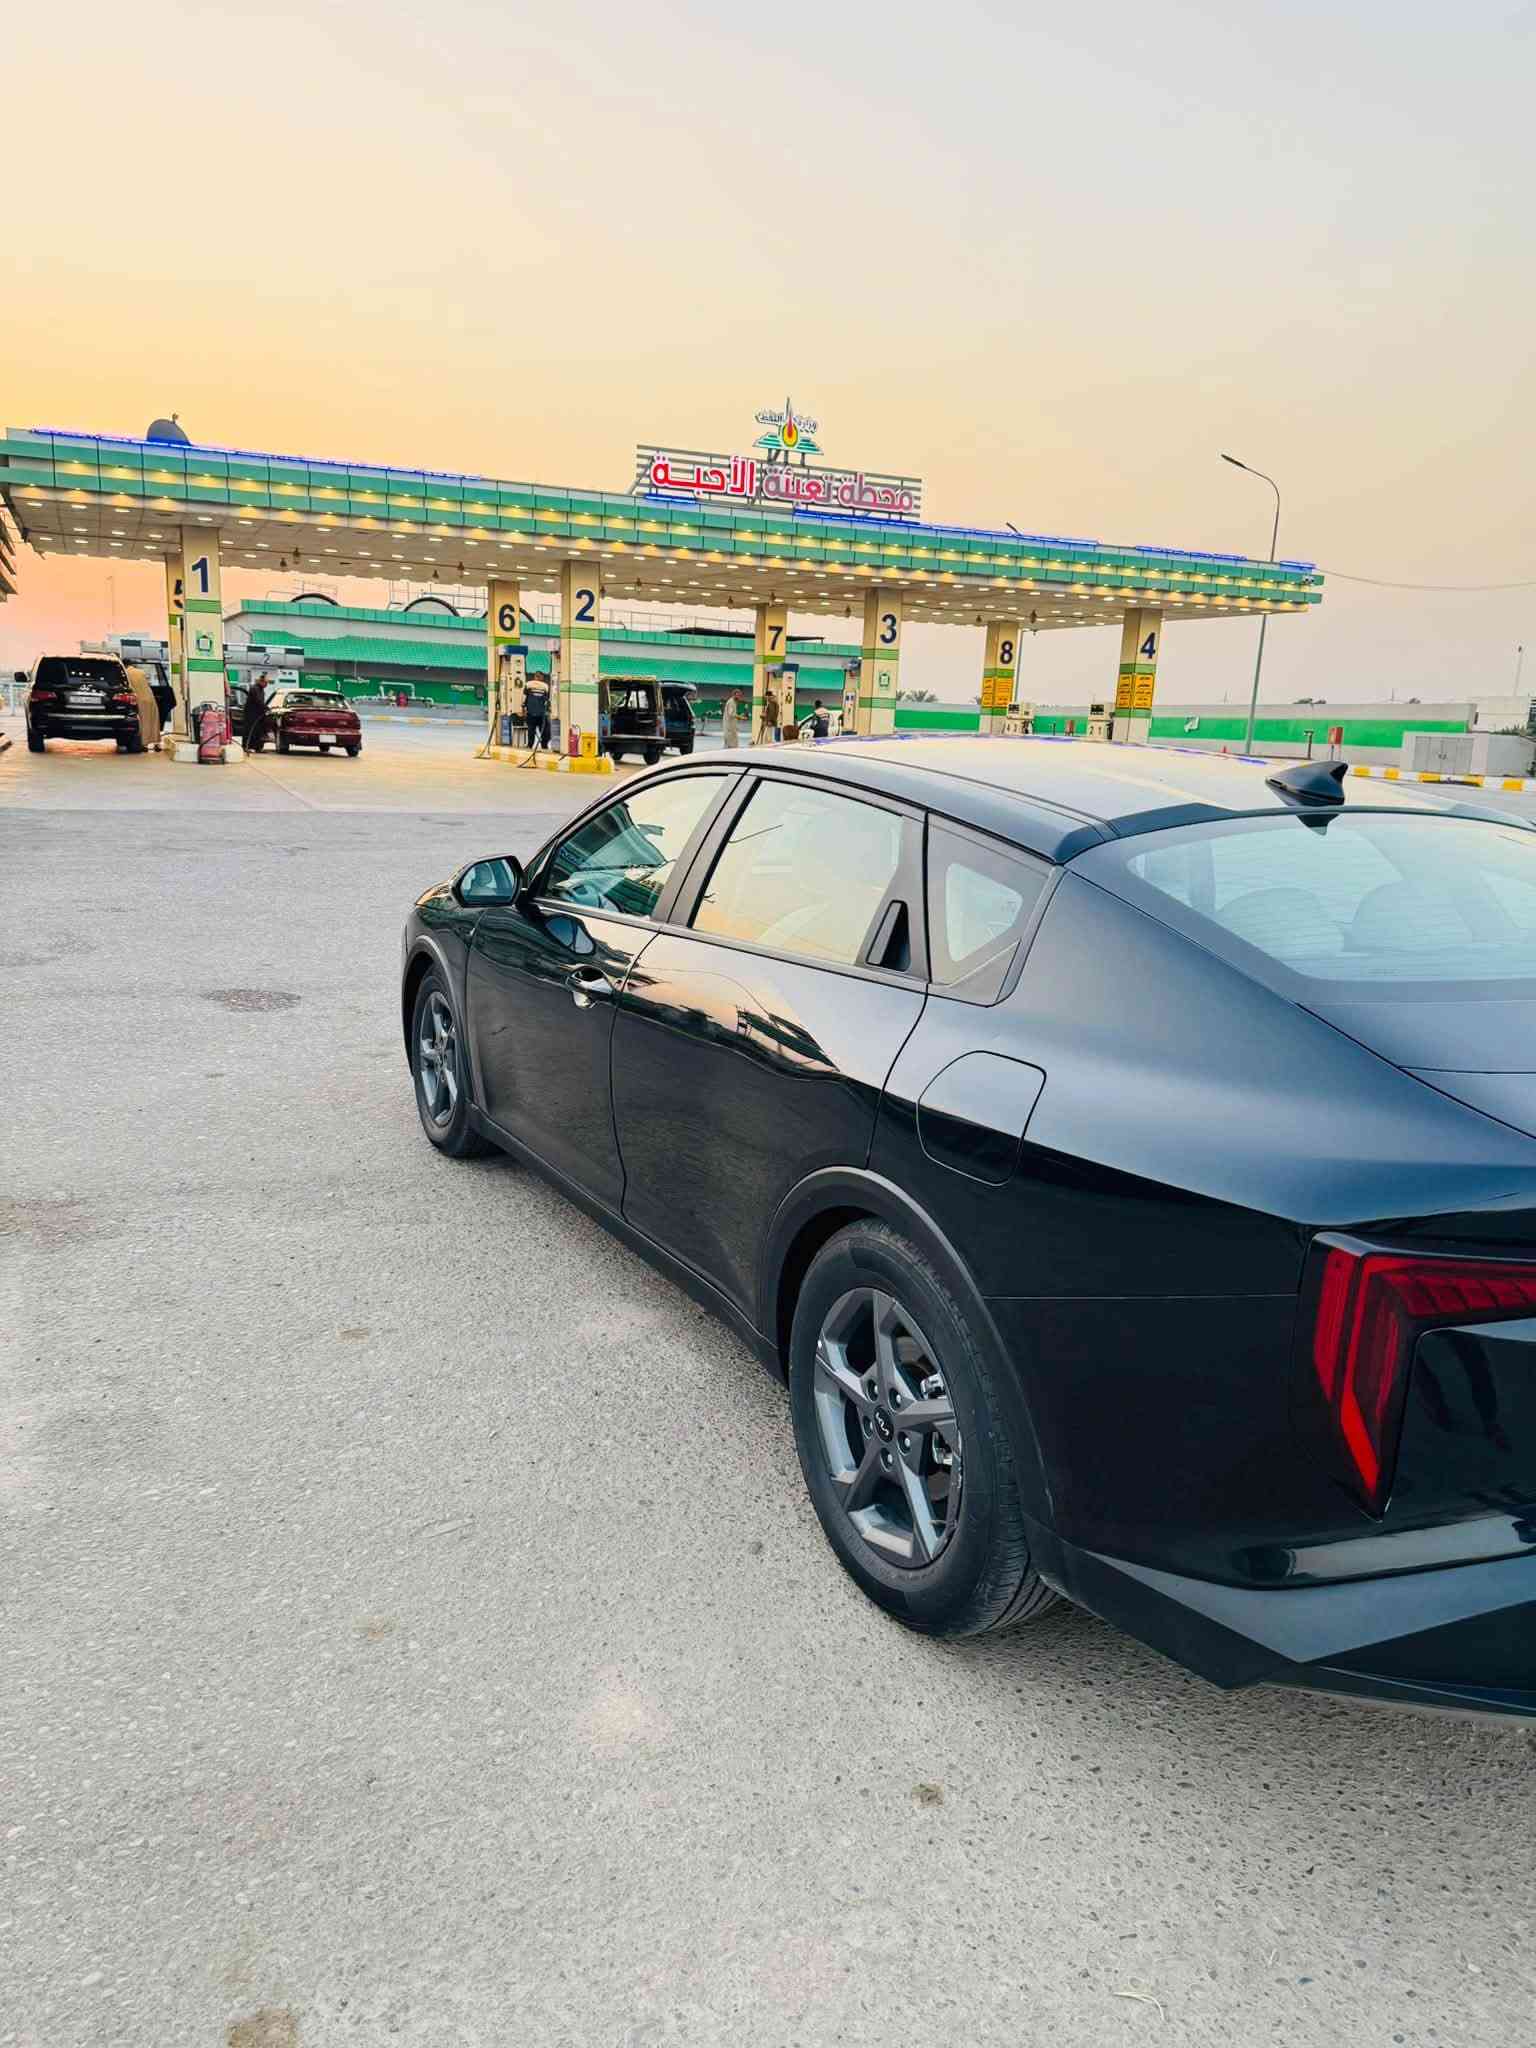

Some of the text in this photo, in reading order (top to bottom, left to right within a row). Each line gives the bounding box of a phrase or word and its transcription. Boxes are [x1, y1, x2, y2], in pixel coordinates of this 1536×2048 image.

[651, 454, 914, 513] محطة تعبئة الأحبة
[191, 557, 209, 593] 1
[498, 603, 516, 632] 6
[575, 589, 596, 623] 2
[768, 626, 784, 651] 7
[880, 613, 898, 644] 3
[1000, 640, 1014, 665] 8
[1140, 632, 1156, 659] 4
